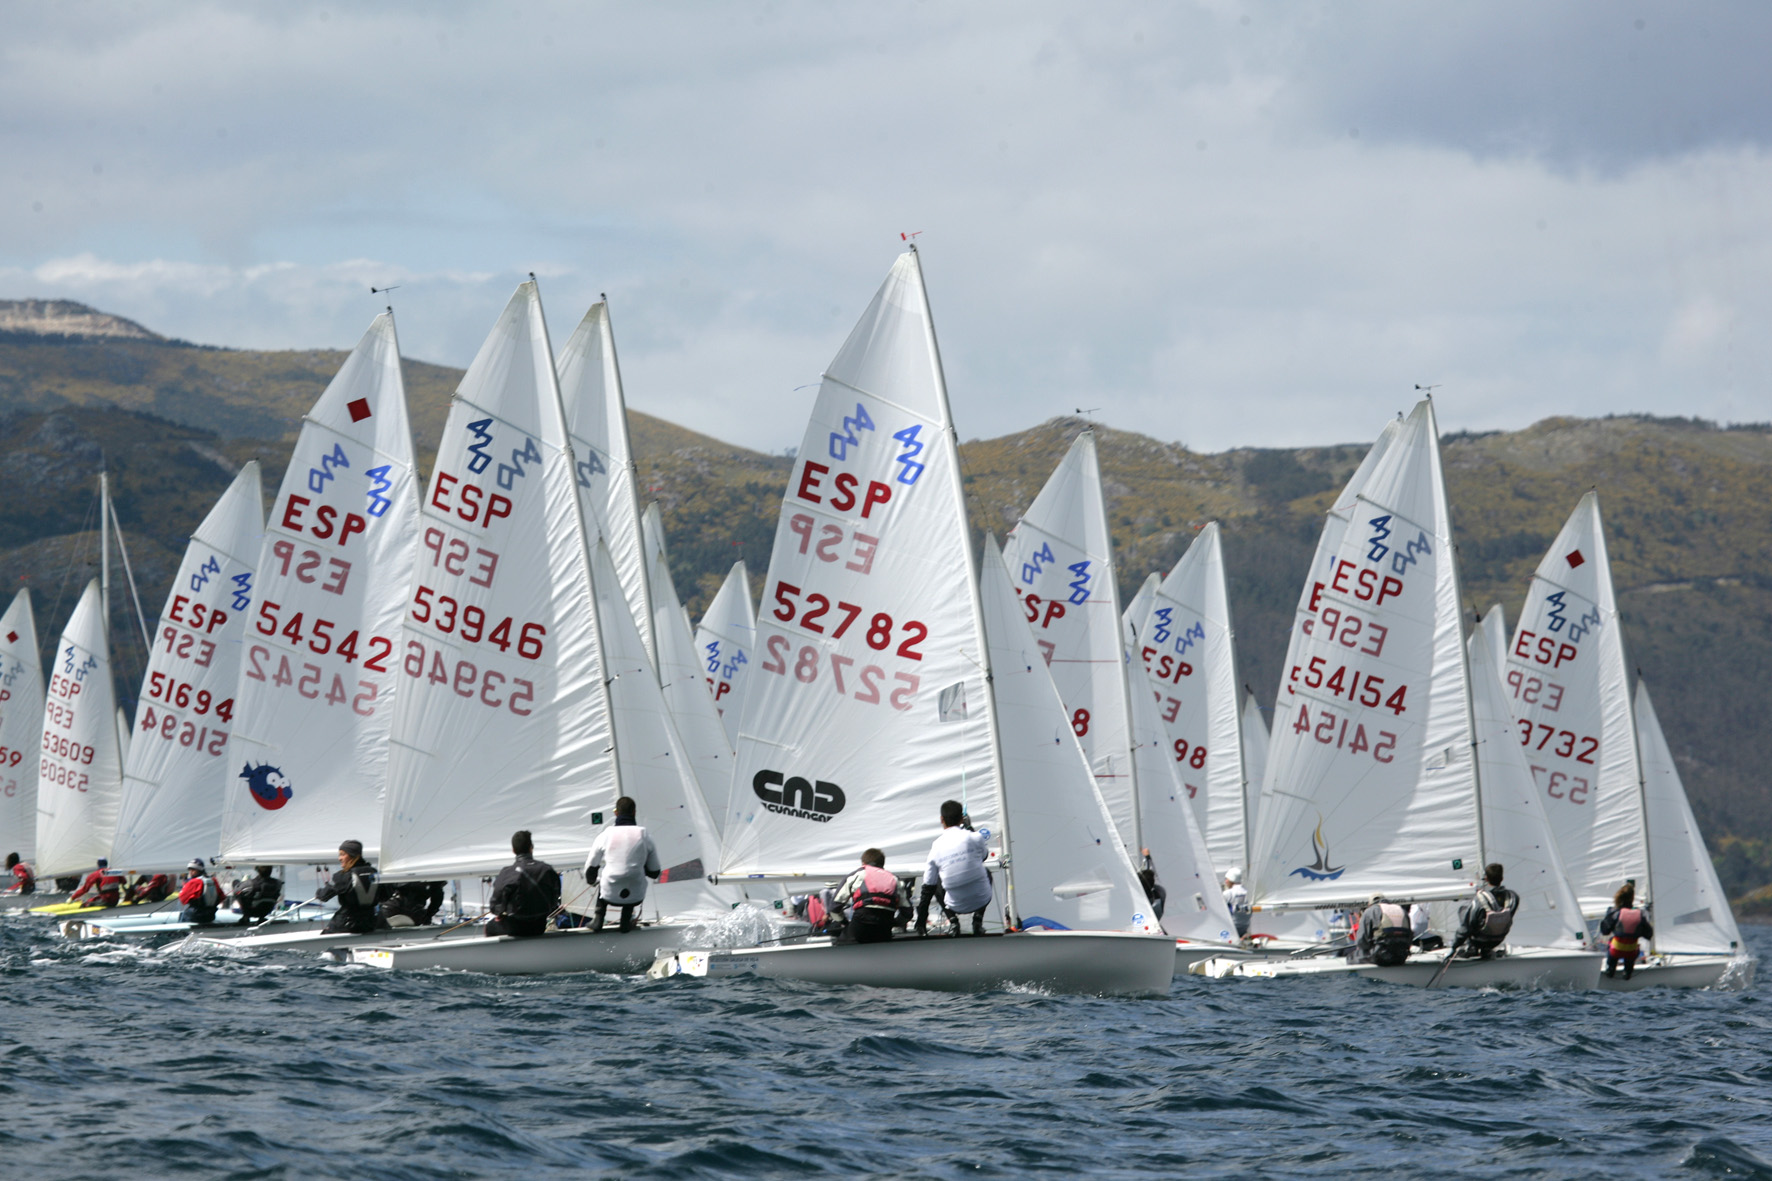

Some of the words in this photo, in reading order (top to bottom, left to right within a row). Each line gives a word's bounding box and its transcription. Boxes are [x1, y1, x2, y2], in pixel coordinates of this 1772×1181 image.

[467, 418, 494, 474] 420
[892, 424, 925, 486] 420
[365, 465, 393, 518] 420
[432, 472, 512, 528] ESP
[798, 460, 892, 519] ESP
[282, 494, 366, 546] ESP
[1367, 515, 1391, 563] 420
[232, 572, 253, 612] 420
[1067, 560, 1092, 606] 420
[1332, 560, 1403, 606] ESP
[169, 594, 227, 634] ESP
[412, 585, 546, 660] 53946
[773, 581, 928, 662] 52782
[1016, 587, 1066, 629] SP
[1153, 608, 1173, 644] 420
[1546, 592, 1565, 632] 420
[256, 600, 392, 673] 54542
[705, 641, 720, 673] 420
[1515, 630, 1578, 668] ESP
[51, 674, 81, 699] ESP
[150, 671, 234, 723] 51694
[1305, 656, 1408, 716] 54154
[43, 731, 94, 765] 53609
[1518, 718, 1599, 764] 3732
